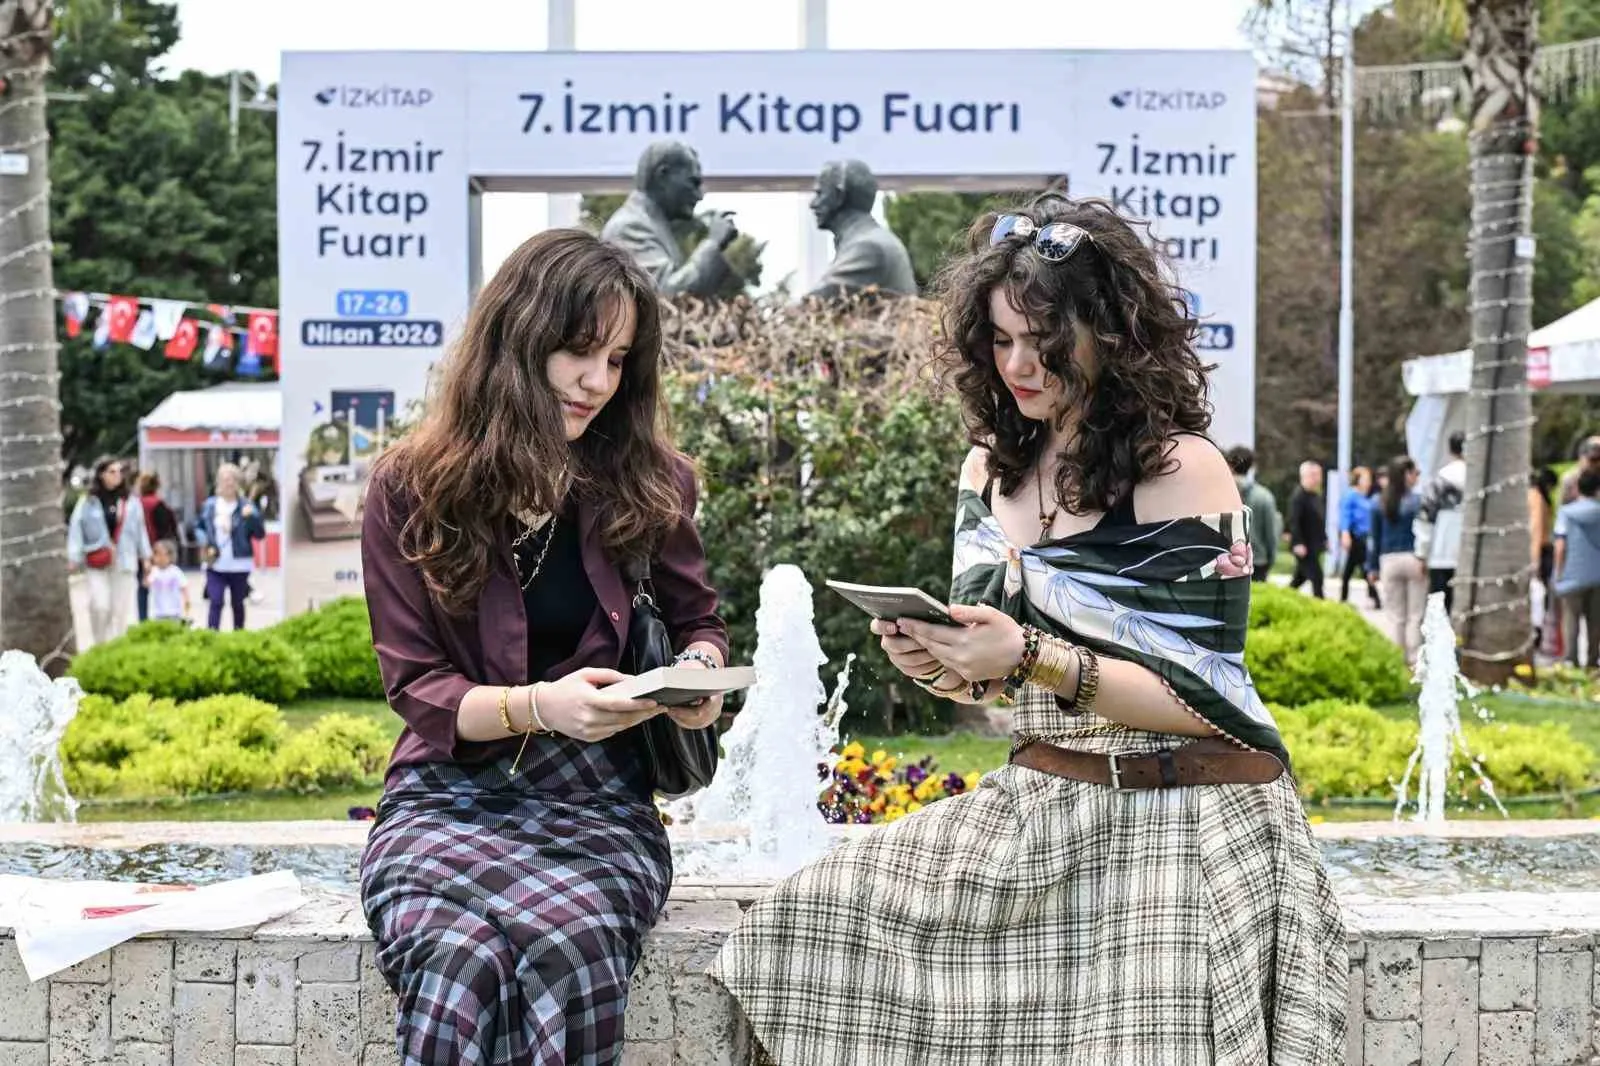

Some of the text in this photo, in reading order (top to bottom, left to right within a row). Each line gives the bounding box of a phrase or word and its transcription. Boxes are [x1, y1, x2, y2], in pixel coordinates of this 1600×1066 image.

[341, 86, 433, 108] İZKİTAP
[1135, 90, 1227, 112] İZKİTAP
[719, 93, 862, 143] Kitap
[883, 92, 1019, 134] Fuarı
[316, 183, 429, 223] Kitap
[1111, 185, 1221, 226] Kitap
[318, 226, 426, 258] Fuarı
[343, 294, 404, 315] 17-26
[306, 323, 437, 344] Nisan 2026
